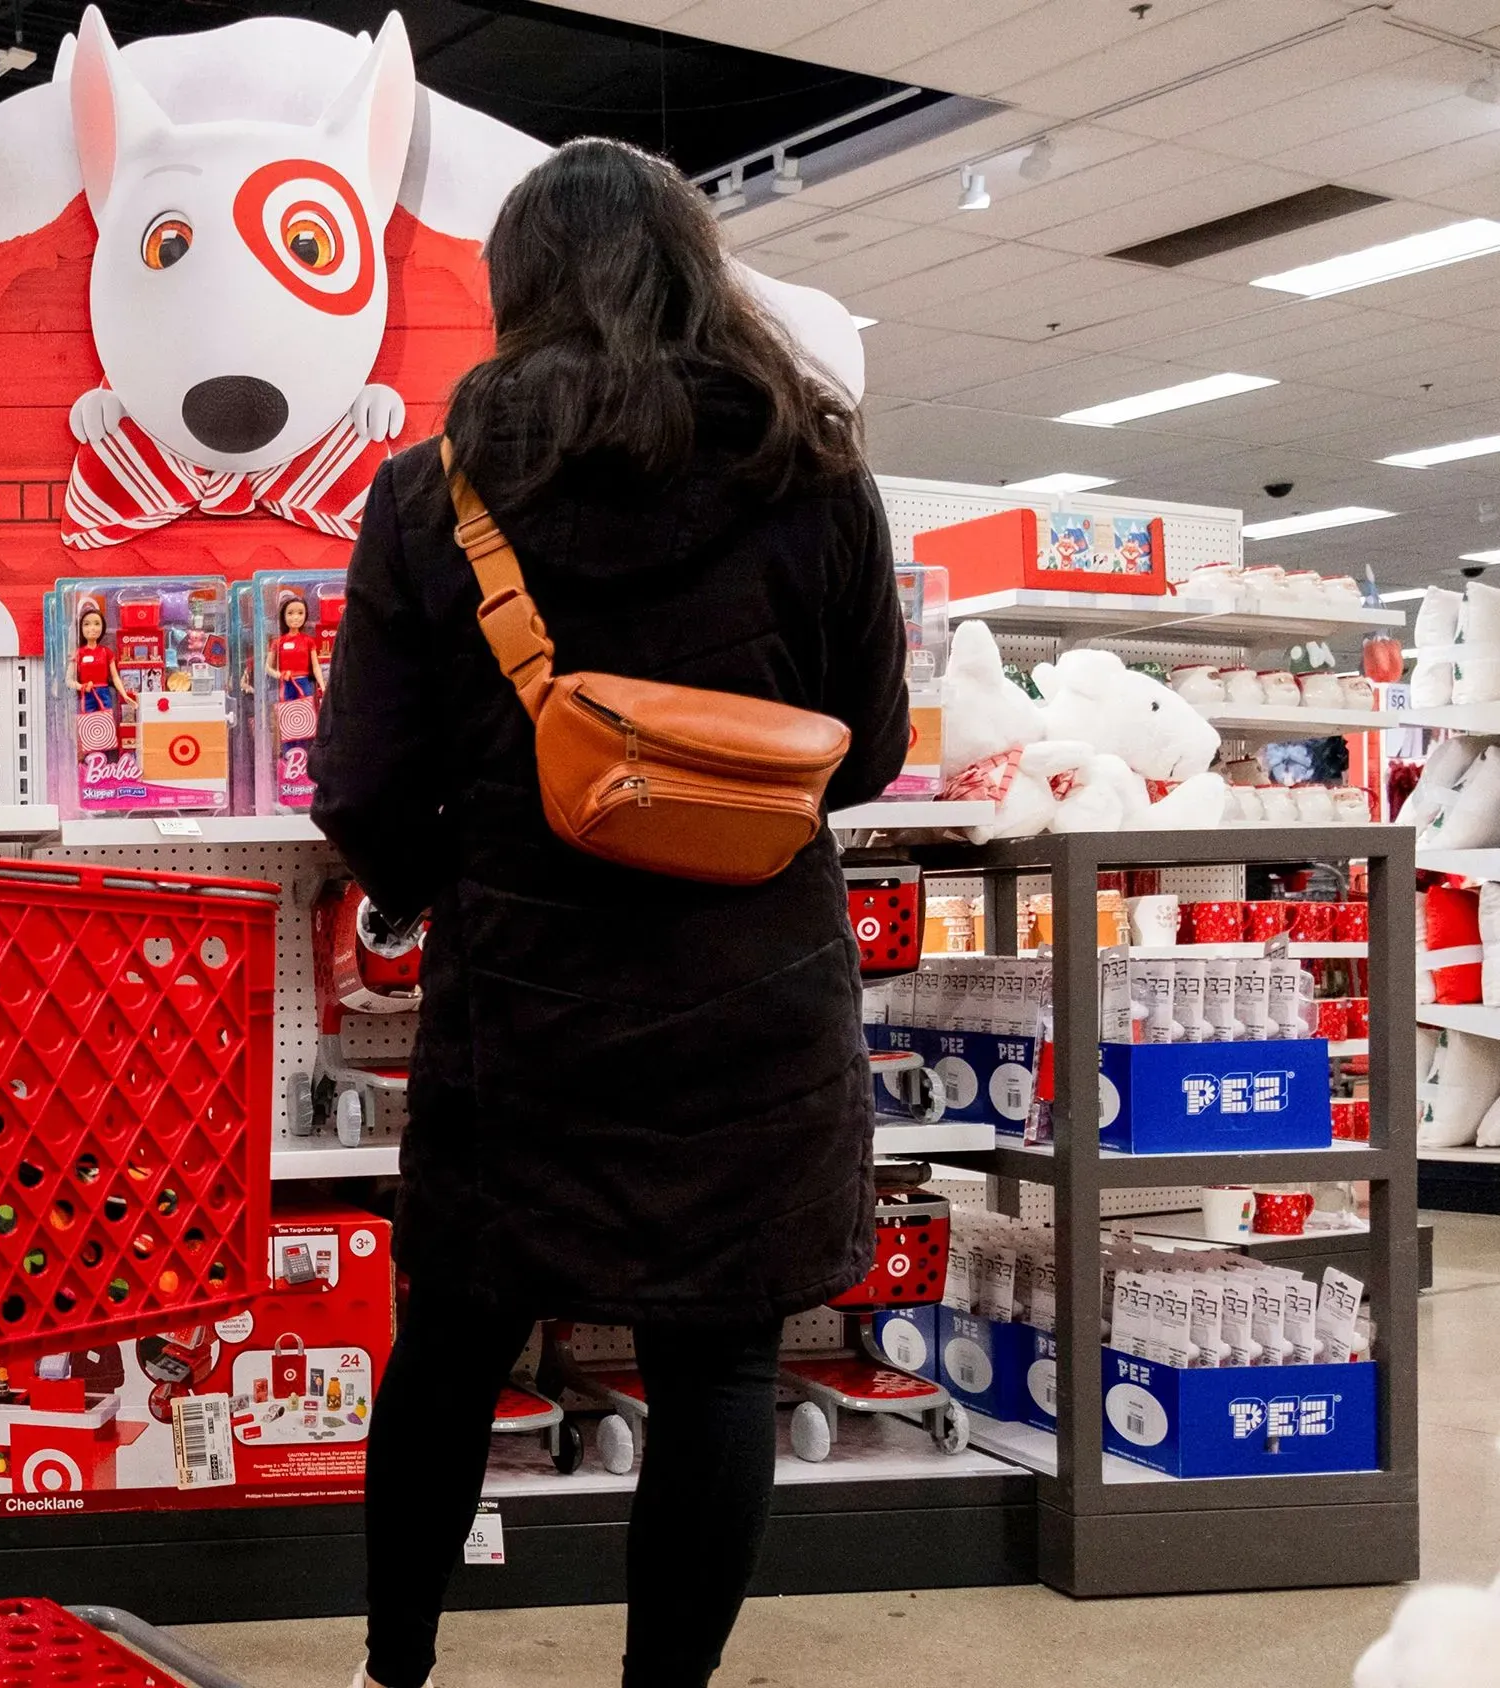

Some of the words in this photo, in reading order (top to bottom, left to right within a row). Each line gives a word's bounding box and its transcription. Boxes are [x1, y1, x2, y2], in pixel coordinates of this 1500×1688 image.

[85, 752, 143, 783] Barbie
[82, 787, 115, 799] Skipper
[889, 1032, 911, 1049] PEZ
[940, 1036, 965, 1054] PEZ
[998, 1042, 1026, 1062] PEZ
[1182, 1071, 1289, 1115] PEZ
[356, 1238, 370, 1250] 3+
[1223, 1295, 1248, 1318] EZ
[1285, 1293, 1312, 1316] EZ
[953, 1316, 979, 1339] PEZ
[1038, 1336, 1057, 1357] PE
[340, 1354, 361, 1368] 24
[1117, 1359, 1151, 1386] PEZ
[1229, 1394, 1335, 1439] PEZ
[5, 1497, 84, 1511] Checklane
